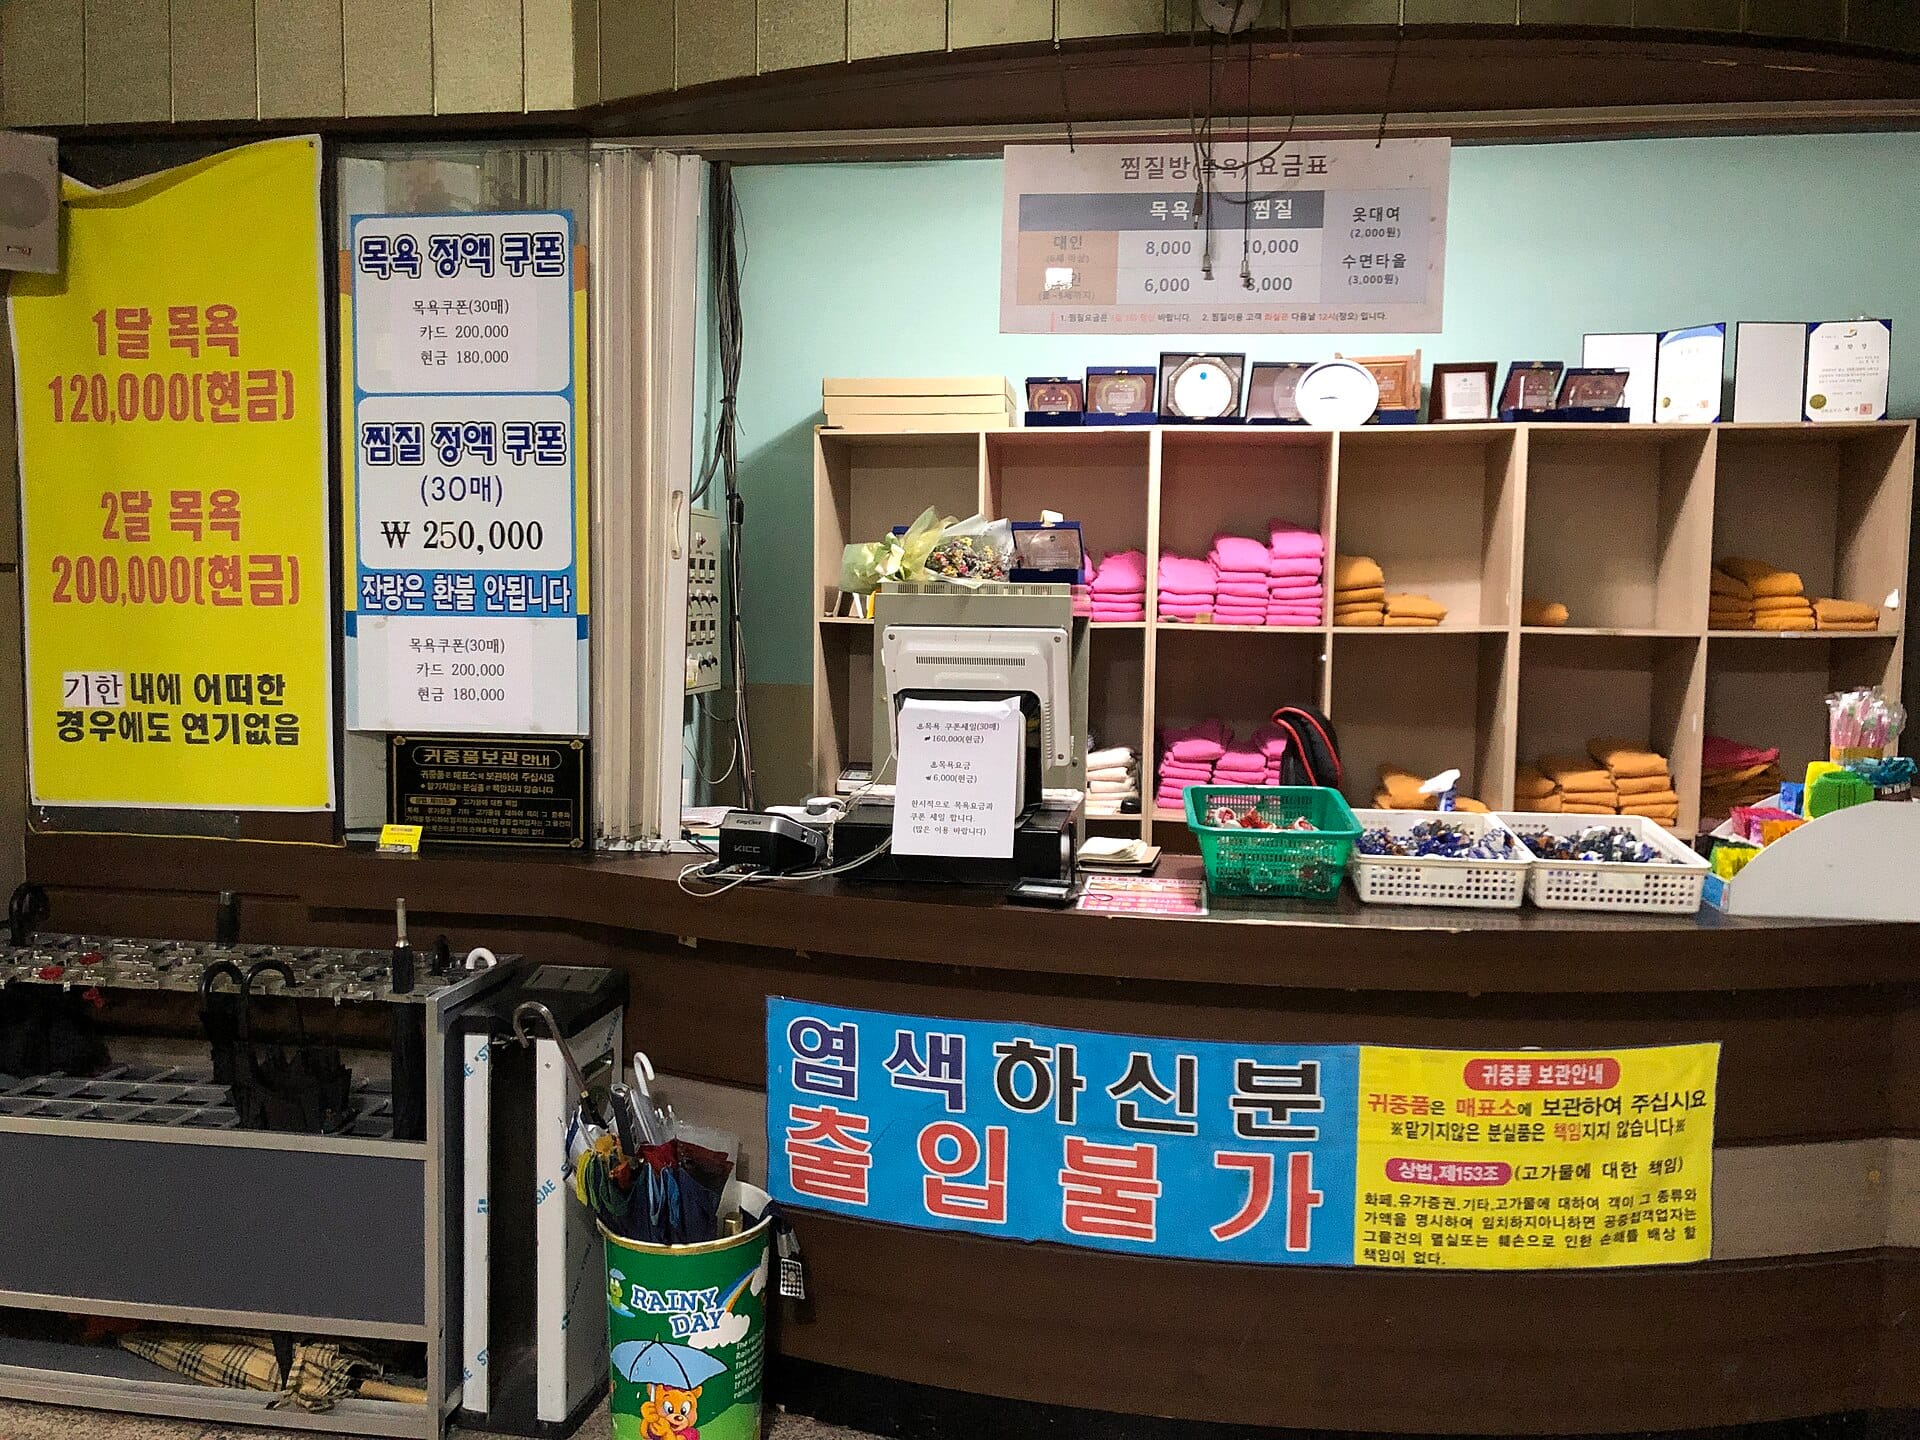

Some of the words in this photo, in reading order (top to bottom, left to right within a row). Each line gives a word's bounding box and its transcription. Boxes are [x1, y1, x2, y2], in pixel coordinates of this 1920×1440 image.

[1256, 153, 1329, 178] 요금표
[1150, 200, 1190, 221] 목욕
[1251, 198, 1293, 220] 찜질
[1352, 206, 1400, 223] 옷대여
[1350, 227, 1401, 239] (2,000원)
[360, 234, 422, 280] 목욕
[429, 232, 494, 279] 정액
[501, 231, 565, 278] 쿠폰
[1053, 234, 1082, 250] 대인
[1145, 240, 1191, 257] 8,000
[1341, 253, 1407, 270] 수면타올
[1144, 278, 1190, 294] 6,000
[1246, 276, 1292, 294] 8,000
[1348, 274, 1399, 286] (3,000원)
[412, 298, 510, 316] 목욕쿠폰(30매)
[91, 305, 152, 359] 1달
[168, 303, 241, 358] 목욕
[419, 325, 449, 341] 카드
[455, 324, 509, 340] 200,000
[420, 350, 449, 366] 현금
[456, 350, 509, 365] 180,000
[48, 368, 295, 424] 120,000(현금)
[362, 421, 425, 466] 찜질
[432, 420, 497, 467] 정액
[502, 420, 567, 466] 쿠폰
[419, 475, 503, 507] (30매)
[101, 489, 152, 543] 2달
[169, 488, 241, 542] 목욕
[423, 520, 544, 556] 250,000
[51, 555, 300, 607] 200,000(현금)
[361, 573, 426, 612] 잔량은
[432, 572, 476, 612] 환불
[483, 574, 572, 614] 안됩니다
[409, 637, 506, 655] 목욕쿠폰(30매)
[416, 662, 444, 678] 카드
[451, 662, 505, 678] 200,000
[64, 674, 124, 707] 기한
[129, 673, 181, 706] 내에
[194, 673, 286, 706] 어떠한
[417, 687, 445, 703] 현금
[453, 687, 505, 703] 180,000
[57, 711, 172, 745] 경우에도
[182, 711, 300, 747] 연기없음
[423, 748, 519, 767] 귀중품보관
[521, 754, 550, 767] 안내
[911, 799, 951, 809] 한시적으로
[954, 800, 994, 811] 목욕요금과
[910, 812, 926, 822] 쿠폰
[930, 812, 946, 822] 세일
[912, 824, 930, 834] (많은
[934, 825, 949, 835] 이용
[953, 826, 987, 836] 바랍니다)
[734, 844, 761, 854] KICC
[1482, 1063, 1532, 1087] 귀중품
[1537, 1063, 1604, 1086] 보관안내
[1367, 1093, 1446, 1116] 귀중품은
[1456, 1098, 1532, 1118] 매표소에
[1541, 1095, 1622, 1117] 보관하여
[1631, 1089, 1707, 1114] 주십시요
[1488, 1122, 1546, 1143] 분실품은
[1554, 1121, 1611, 1142] 책임지지
[1514, 1162, 1591, 1182] (고가물에
[1602, 1160, 1638, 1180] 대한
[1648, 1155, 1684, 1177] 책임)
[1558, 1195, 1600, 1211] 대하여
[1608, 1195, 1634, 1209] 객이
[1639, 1193, 1651, 1206] 그
[1657, 1187, 1697, 1204] 종류와
[1364, 1211, 1407, 1227] 가액을
[1416, 1213, 1473, 1229] 명시하여
[1482, 1215, 1596, 1230] 임치하지아니하면
[1363, 1230, 1423, 1246] 그물건의
[1431, 1233, 1488, 1248] 멸실또는
[1500, 1234, 1556, 1248] 훼손으로
[1564, 1234, 1592, 1248] 인한
[1600, 1229, 1639, 1246] 손해를
[1647, 1227, 1676, 1242] 배상
[1684, 1225, 1696, 1240] 할
[1364, 1247, 1405, 1263] 책임이
[1413, 1251, 1446, 1265] 없다.
[631, 1284, 719, 1314] RAINY
[670, 1308, 725, 1338] DAY
